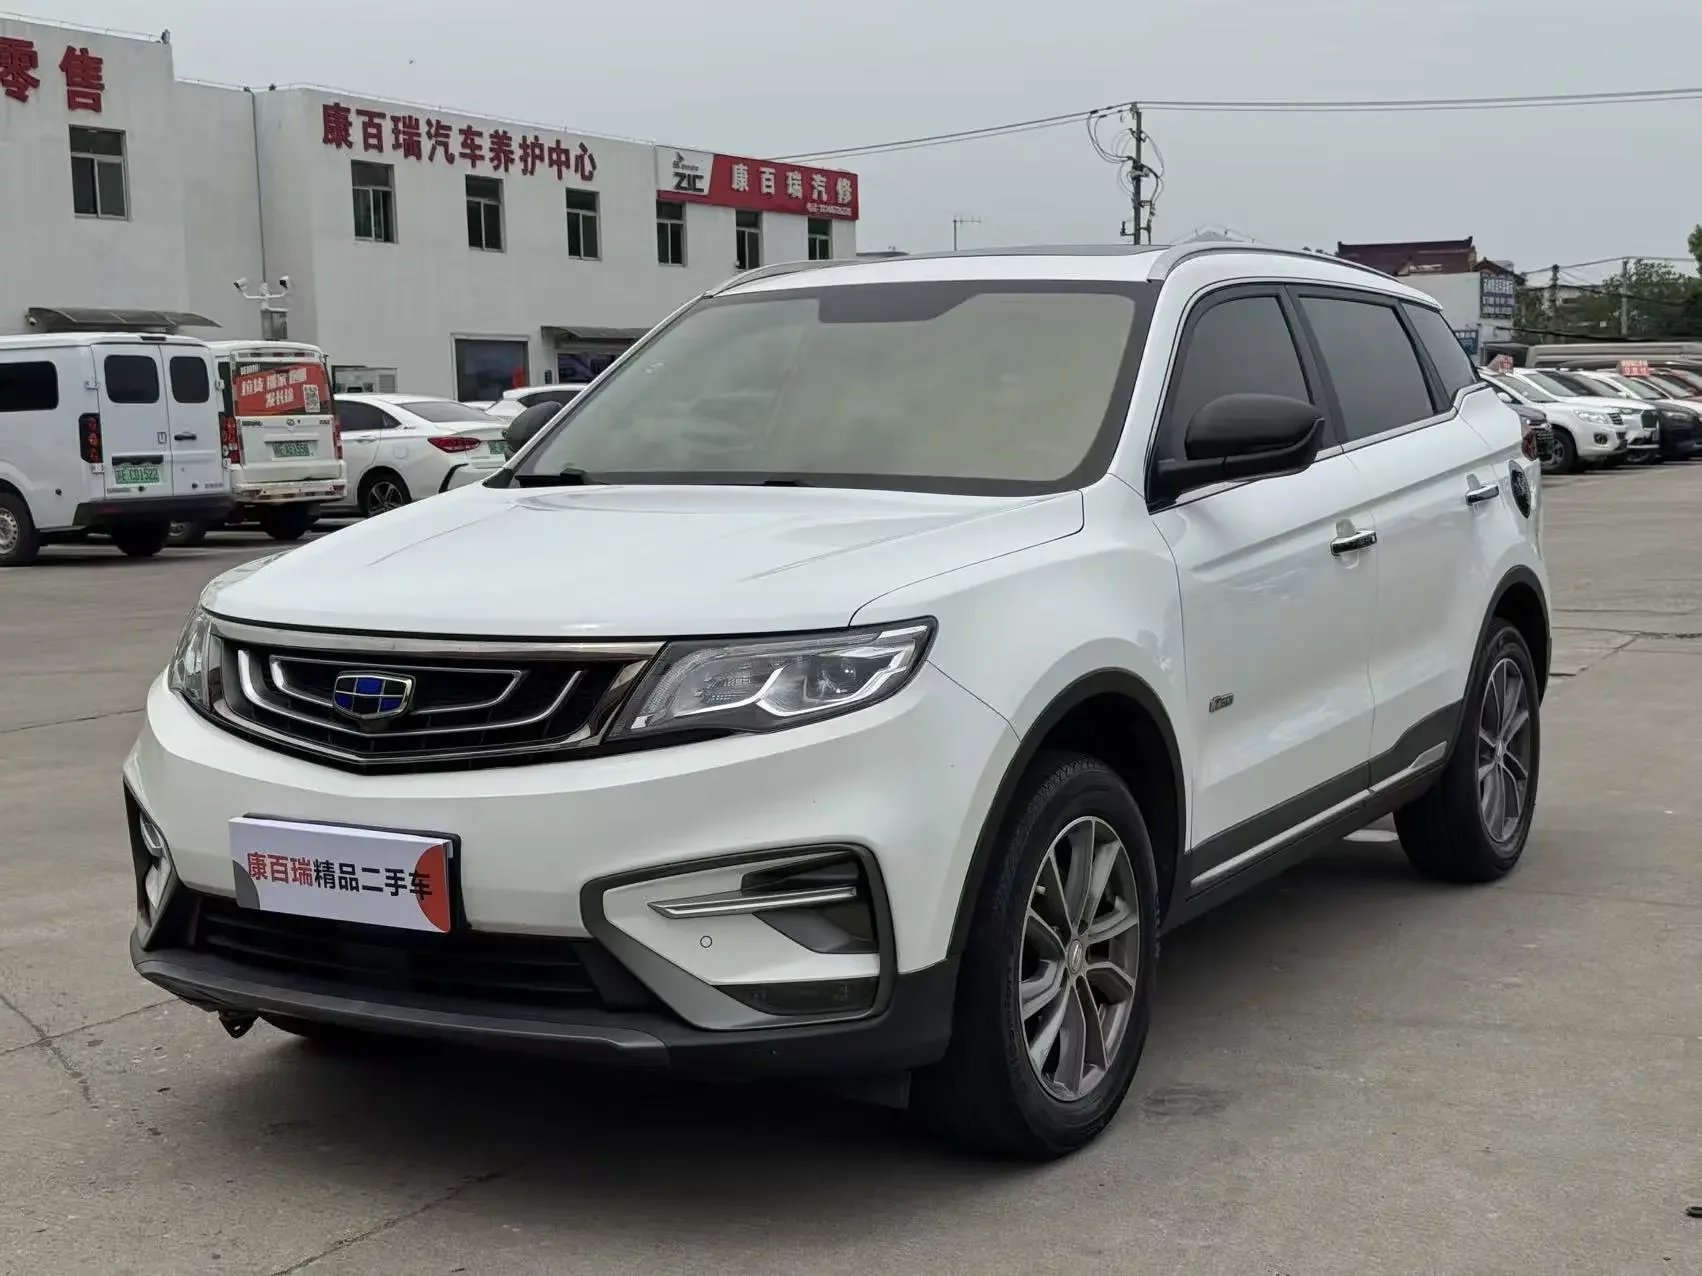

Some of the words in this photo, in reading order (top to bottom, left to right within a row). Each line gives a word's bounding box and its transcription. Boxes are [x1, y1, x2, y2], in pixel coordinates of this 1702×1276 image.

[0, 36, 106, 114] 零售
[321, 102, 598, 182] 康百瑞汽车养护中心
[673, 171, 705, 193] ZIC
[731, 163, 853, 204] 康百瑞汽修
[246, 851, 433, 901] 康百瑞精品二手车
